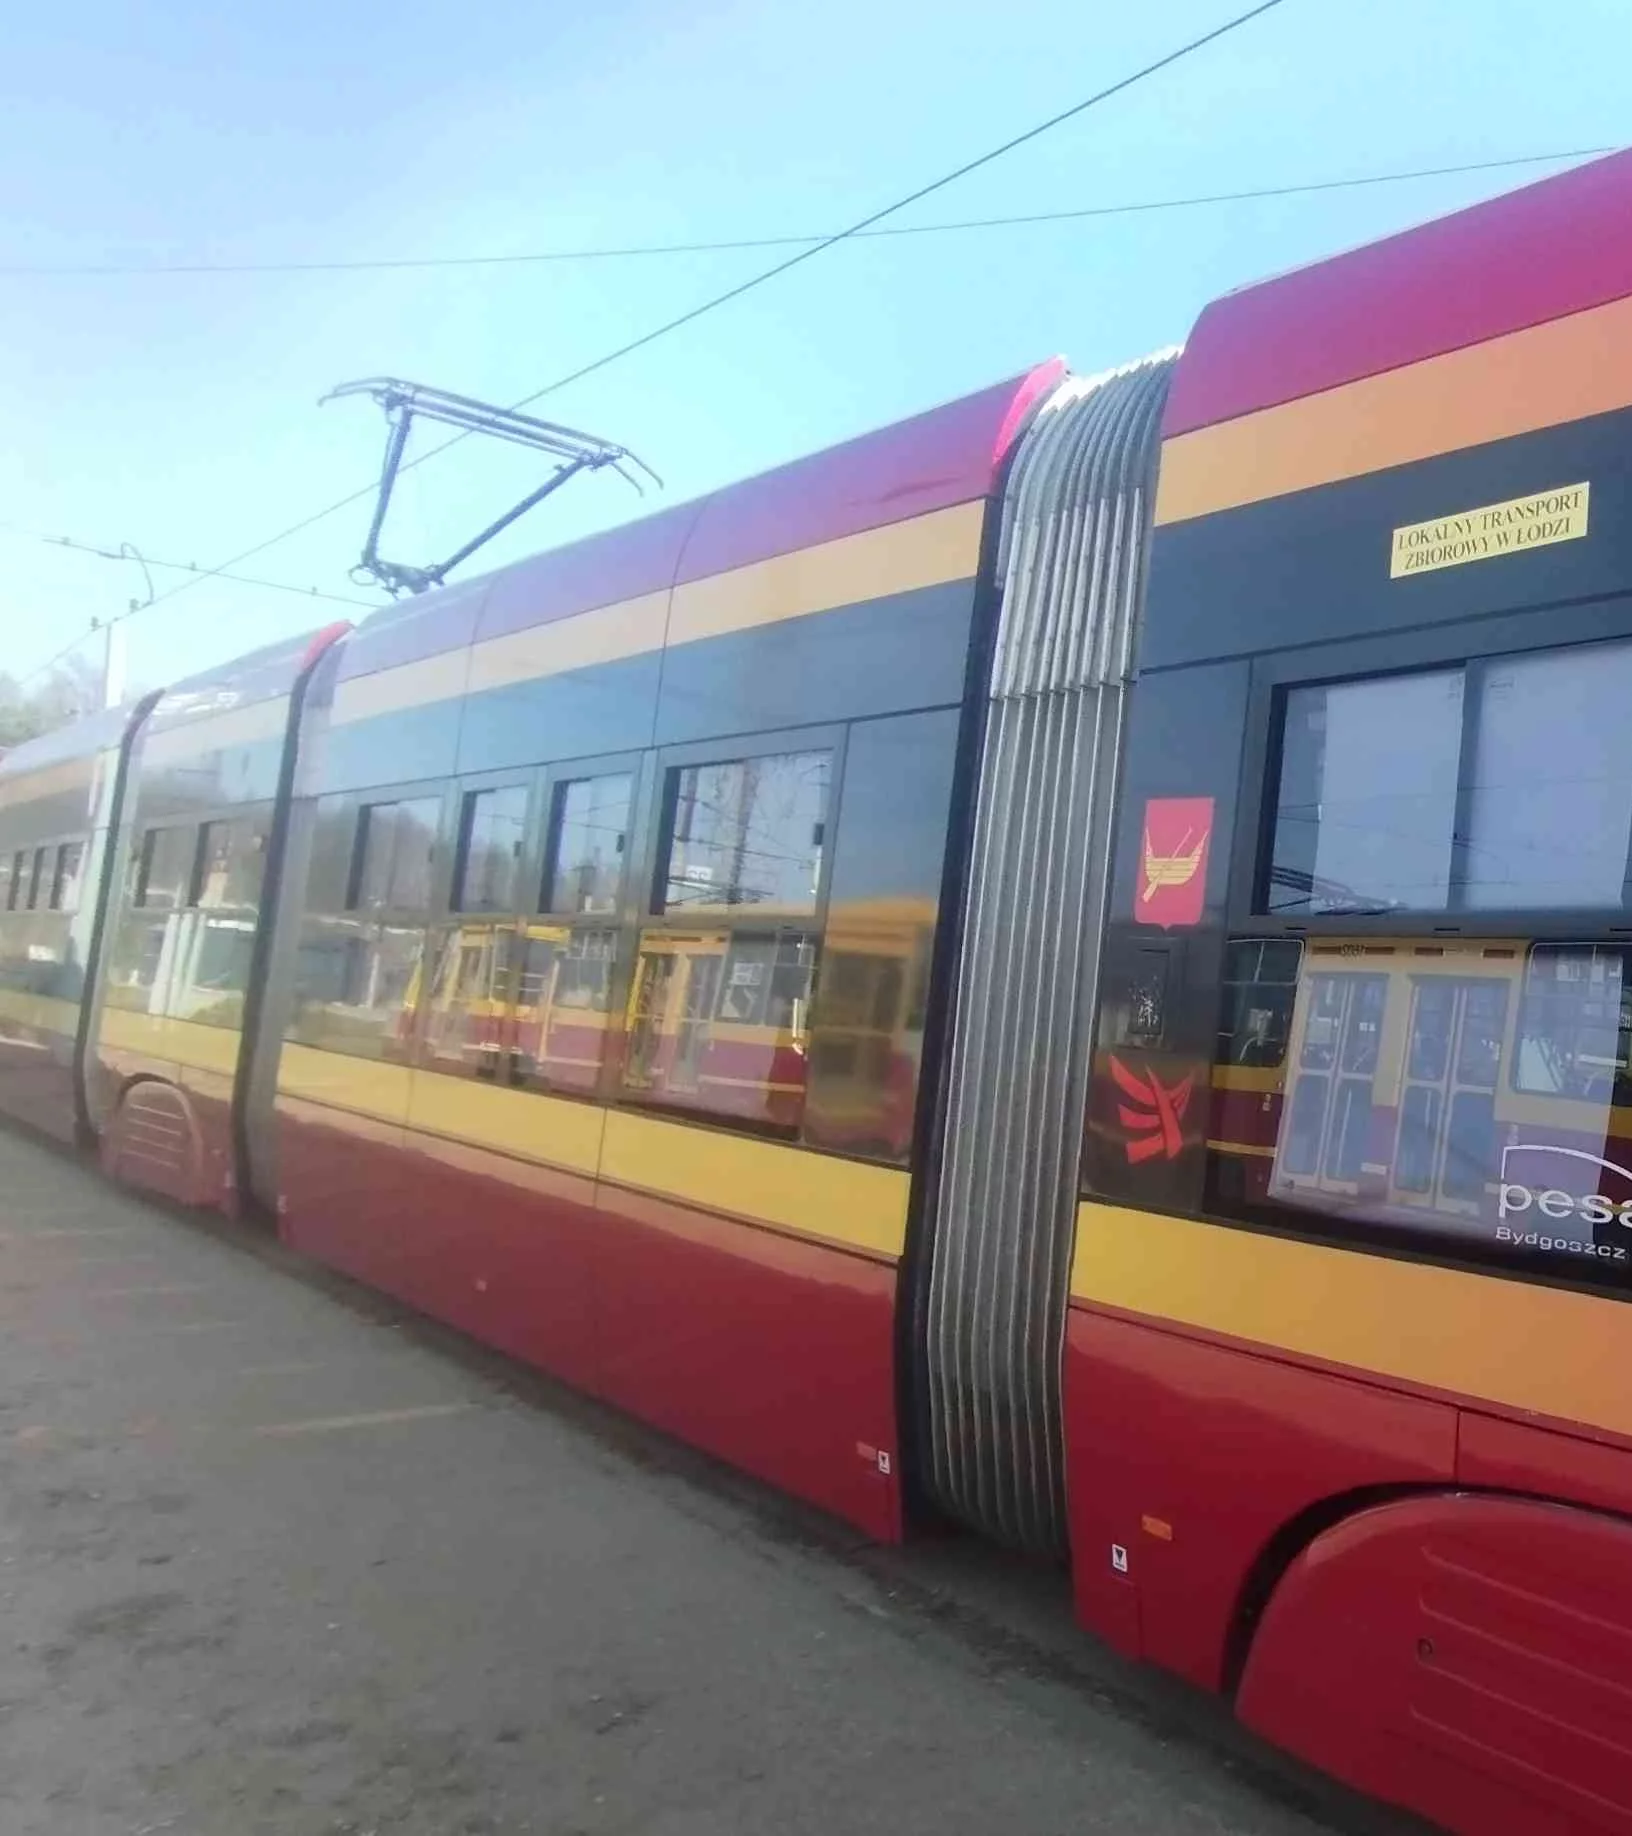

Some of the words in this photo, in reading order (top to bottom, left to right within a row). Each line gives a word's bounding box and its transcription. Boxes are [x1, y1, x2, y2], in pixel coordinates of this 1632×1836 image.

[1399, 517, 1476, 551] LOKALNY
[1480, 490, 1582, 531] TRANSPORT
[1404, 537, 1490, 570] ZBIOROWY
[1496, 533, 1512, 549] W
[1495, 1226, 1627, 1260] Bydgoszcz
